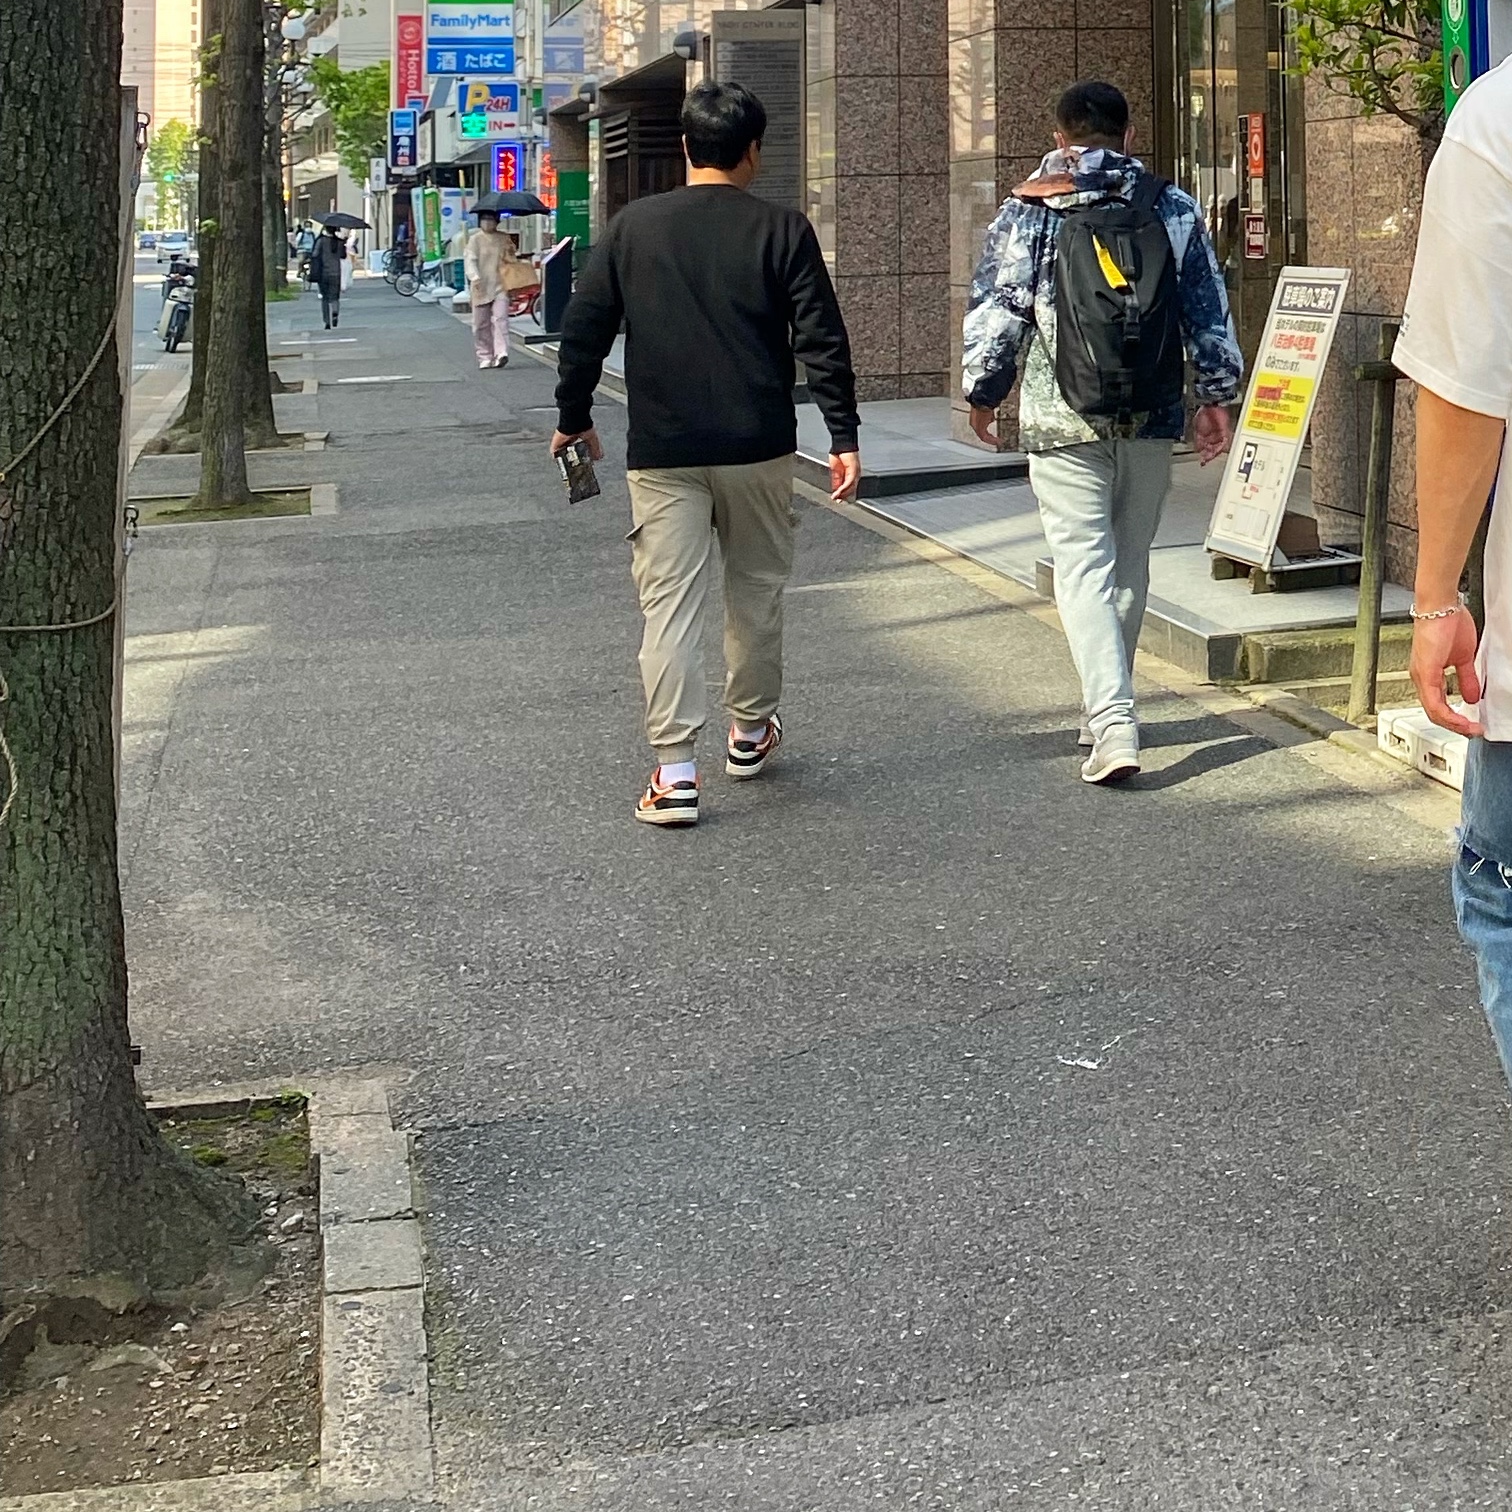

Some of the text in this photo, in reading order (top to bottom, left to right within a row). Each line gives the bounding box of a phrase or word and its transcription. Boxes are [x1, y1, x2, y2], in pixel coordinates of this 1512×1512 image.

[431, 14, 511, 29] FamilyMart
[436, 51, 506, 70] 酒 たばこ
[465, 82, 511, 112] P 24H
[489, 121, 502, 131] IN
